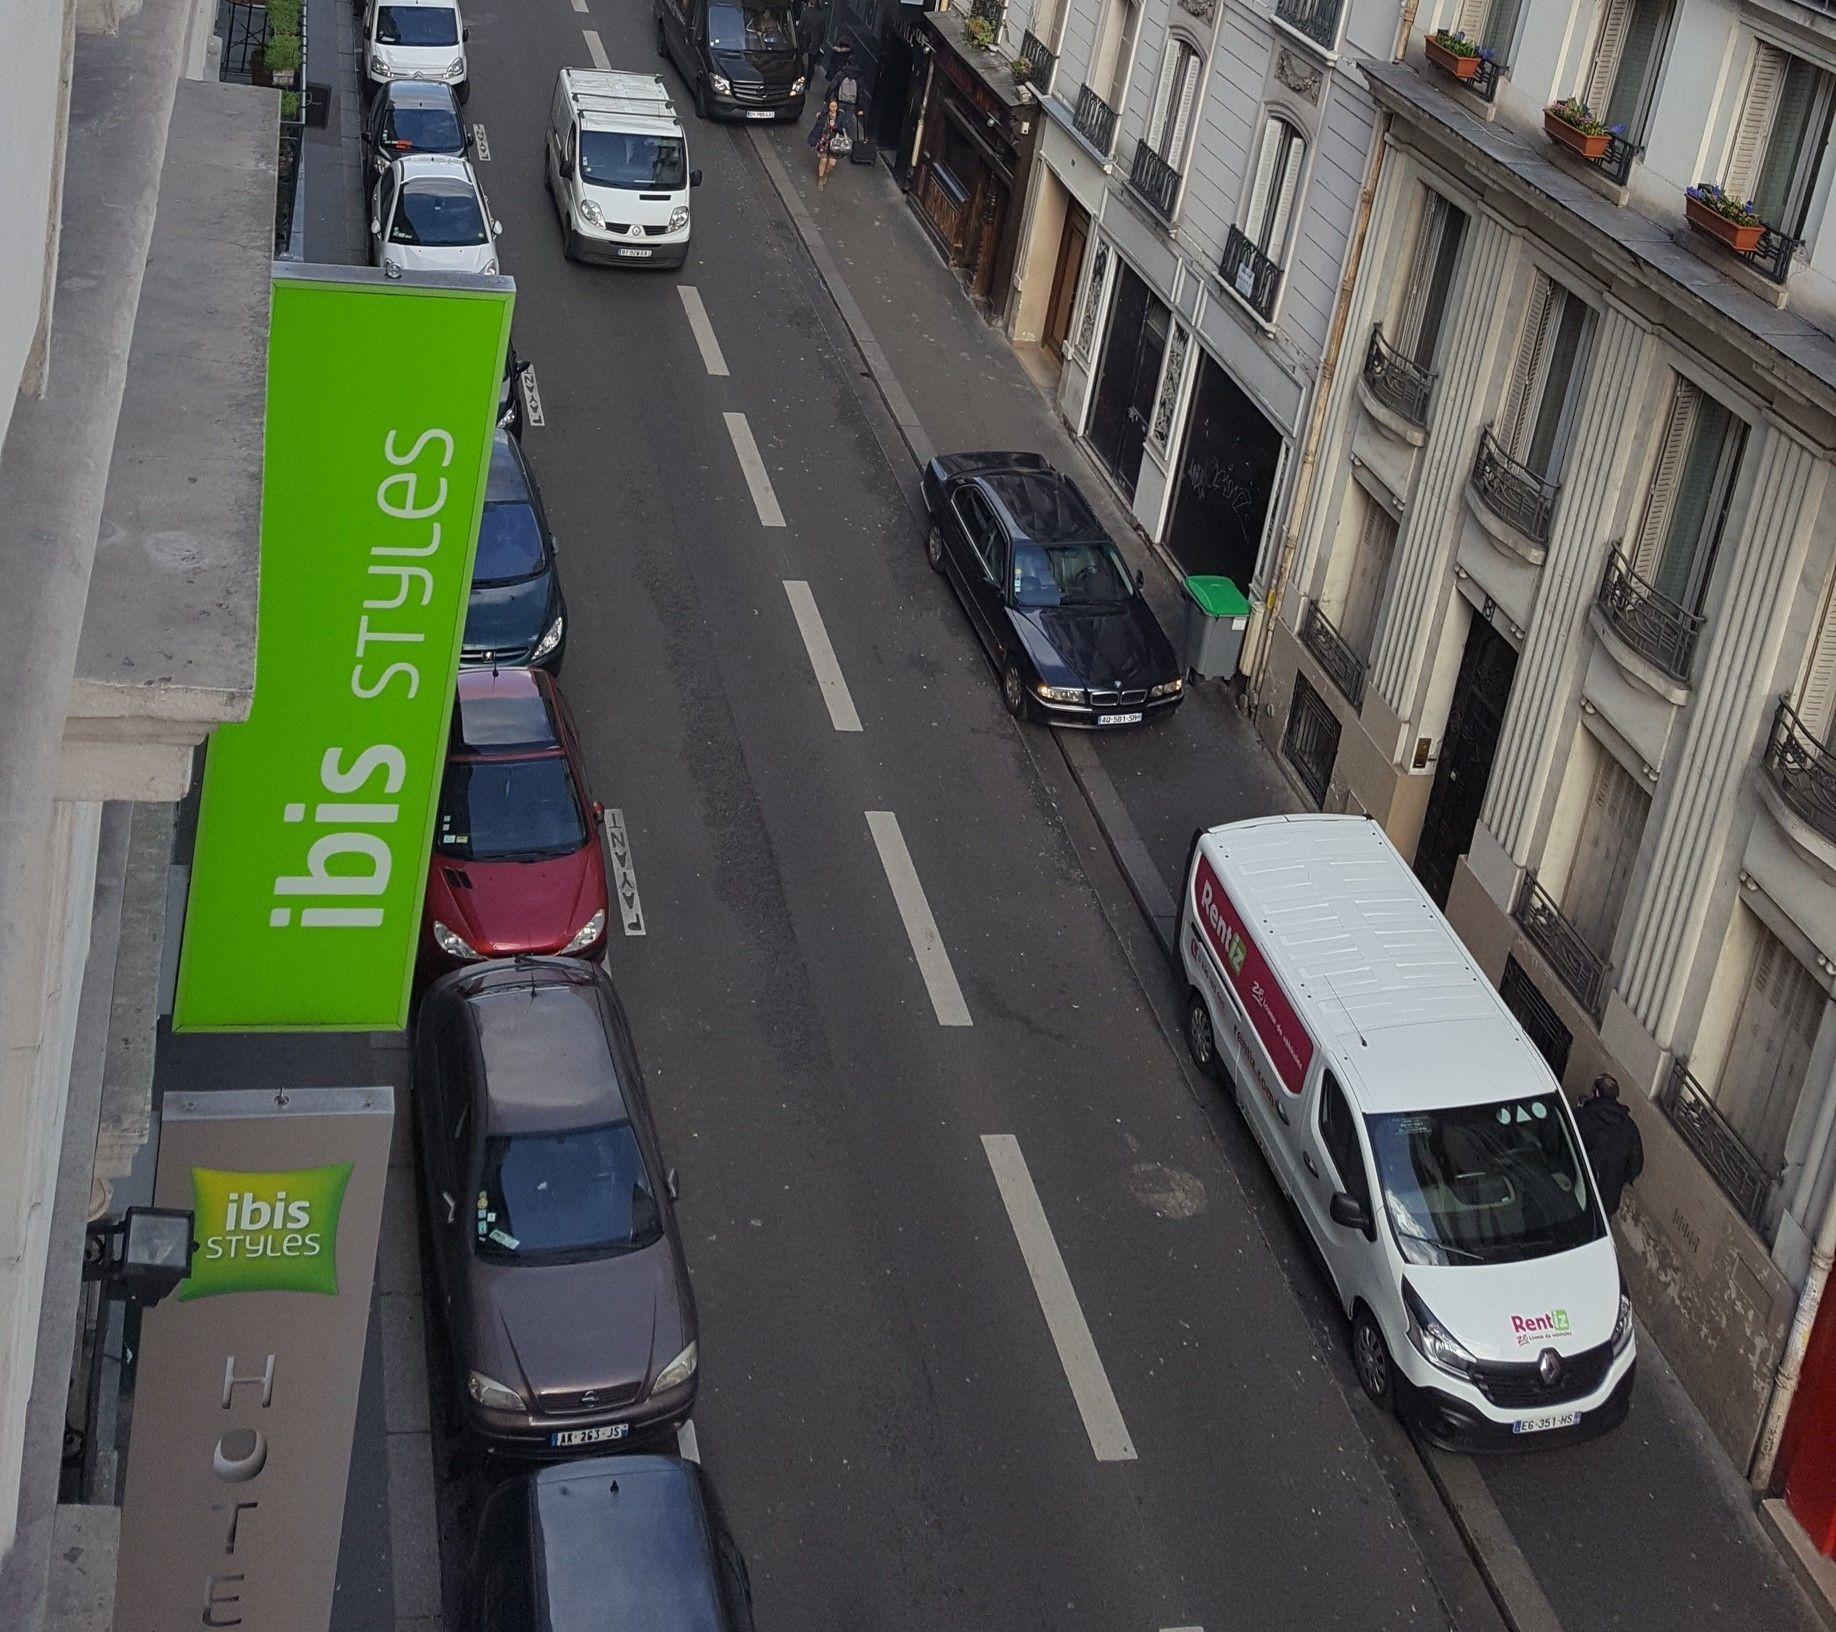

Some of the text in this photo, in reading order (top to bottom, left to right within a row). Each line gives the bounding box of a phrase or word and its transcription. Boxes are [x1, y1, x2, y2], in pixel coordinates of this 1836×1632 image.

[269, 744, 407, 927] ibis
[608, 813, 642, 931] PAYANT
[224, 1191, 310, 1231] ibis
